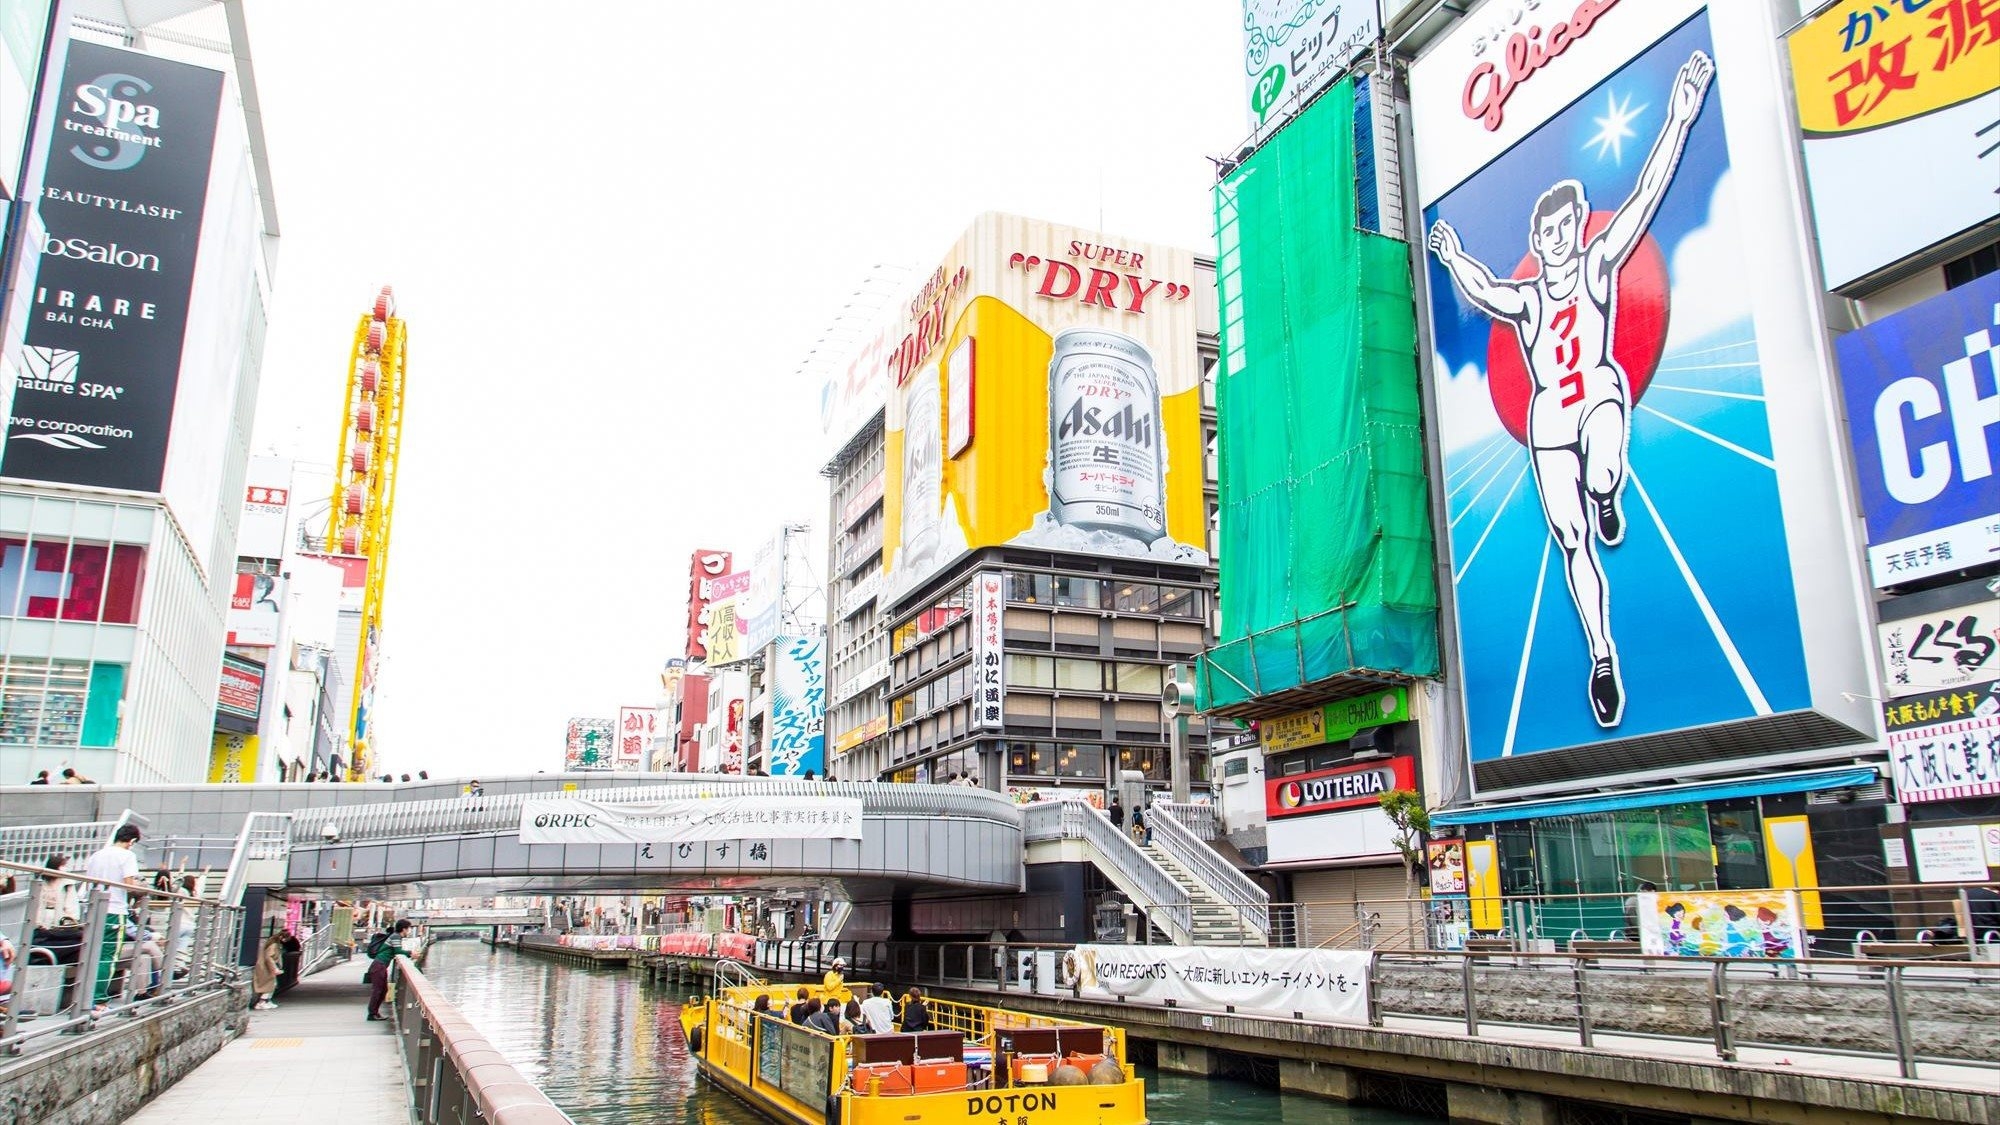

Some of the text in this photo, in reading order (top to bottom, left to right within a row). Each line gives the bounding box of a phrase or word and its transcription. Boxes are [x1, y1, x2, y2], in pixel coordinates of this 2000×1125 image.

[1290, 5, 1341, 77] ピップ
[1462, 0, 1622, 131] Glico
[73, 84, 160, 129] Spa
[64, 118, 162, 148] treatment
[1068, 240, 1144, 270] SUPER
[1549, 296, 1585, 409] グリコ
[37, 418, 133, 439] corporation
[1058, 395, 1151, 449] Asahi
[1092, 445, 1120, 466] 生
[1079, 472, 1135, 487] スーパードライ
[1095, 504, 1120, 517] 350ml
[1886, 541, 1953, 574] 天気予報
[711, 606, 723, 662] バイト
[721, 604, 735, 660] 高収入
[986, 598, 998, 647] 本場の味
[1908, 615, 1996, 672] くくる
[985, 650, 1000, 721] かに道楽
[1886, 691, 1979, 727] 大阪もんを食す
[1304, 771, 1384, 801] LOTTERIA
[640, 842, 768, 861] えびす橋
[1096, 963, 1119, 978] MGM
[1120, 964, 1167, 980] RESORTS
[967, 1092, 1057, 1116] DOTON
